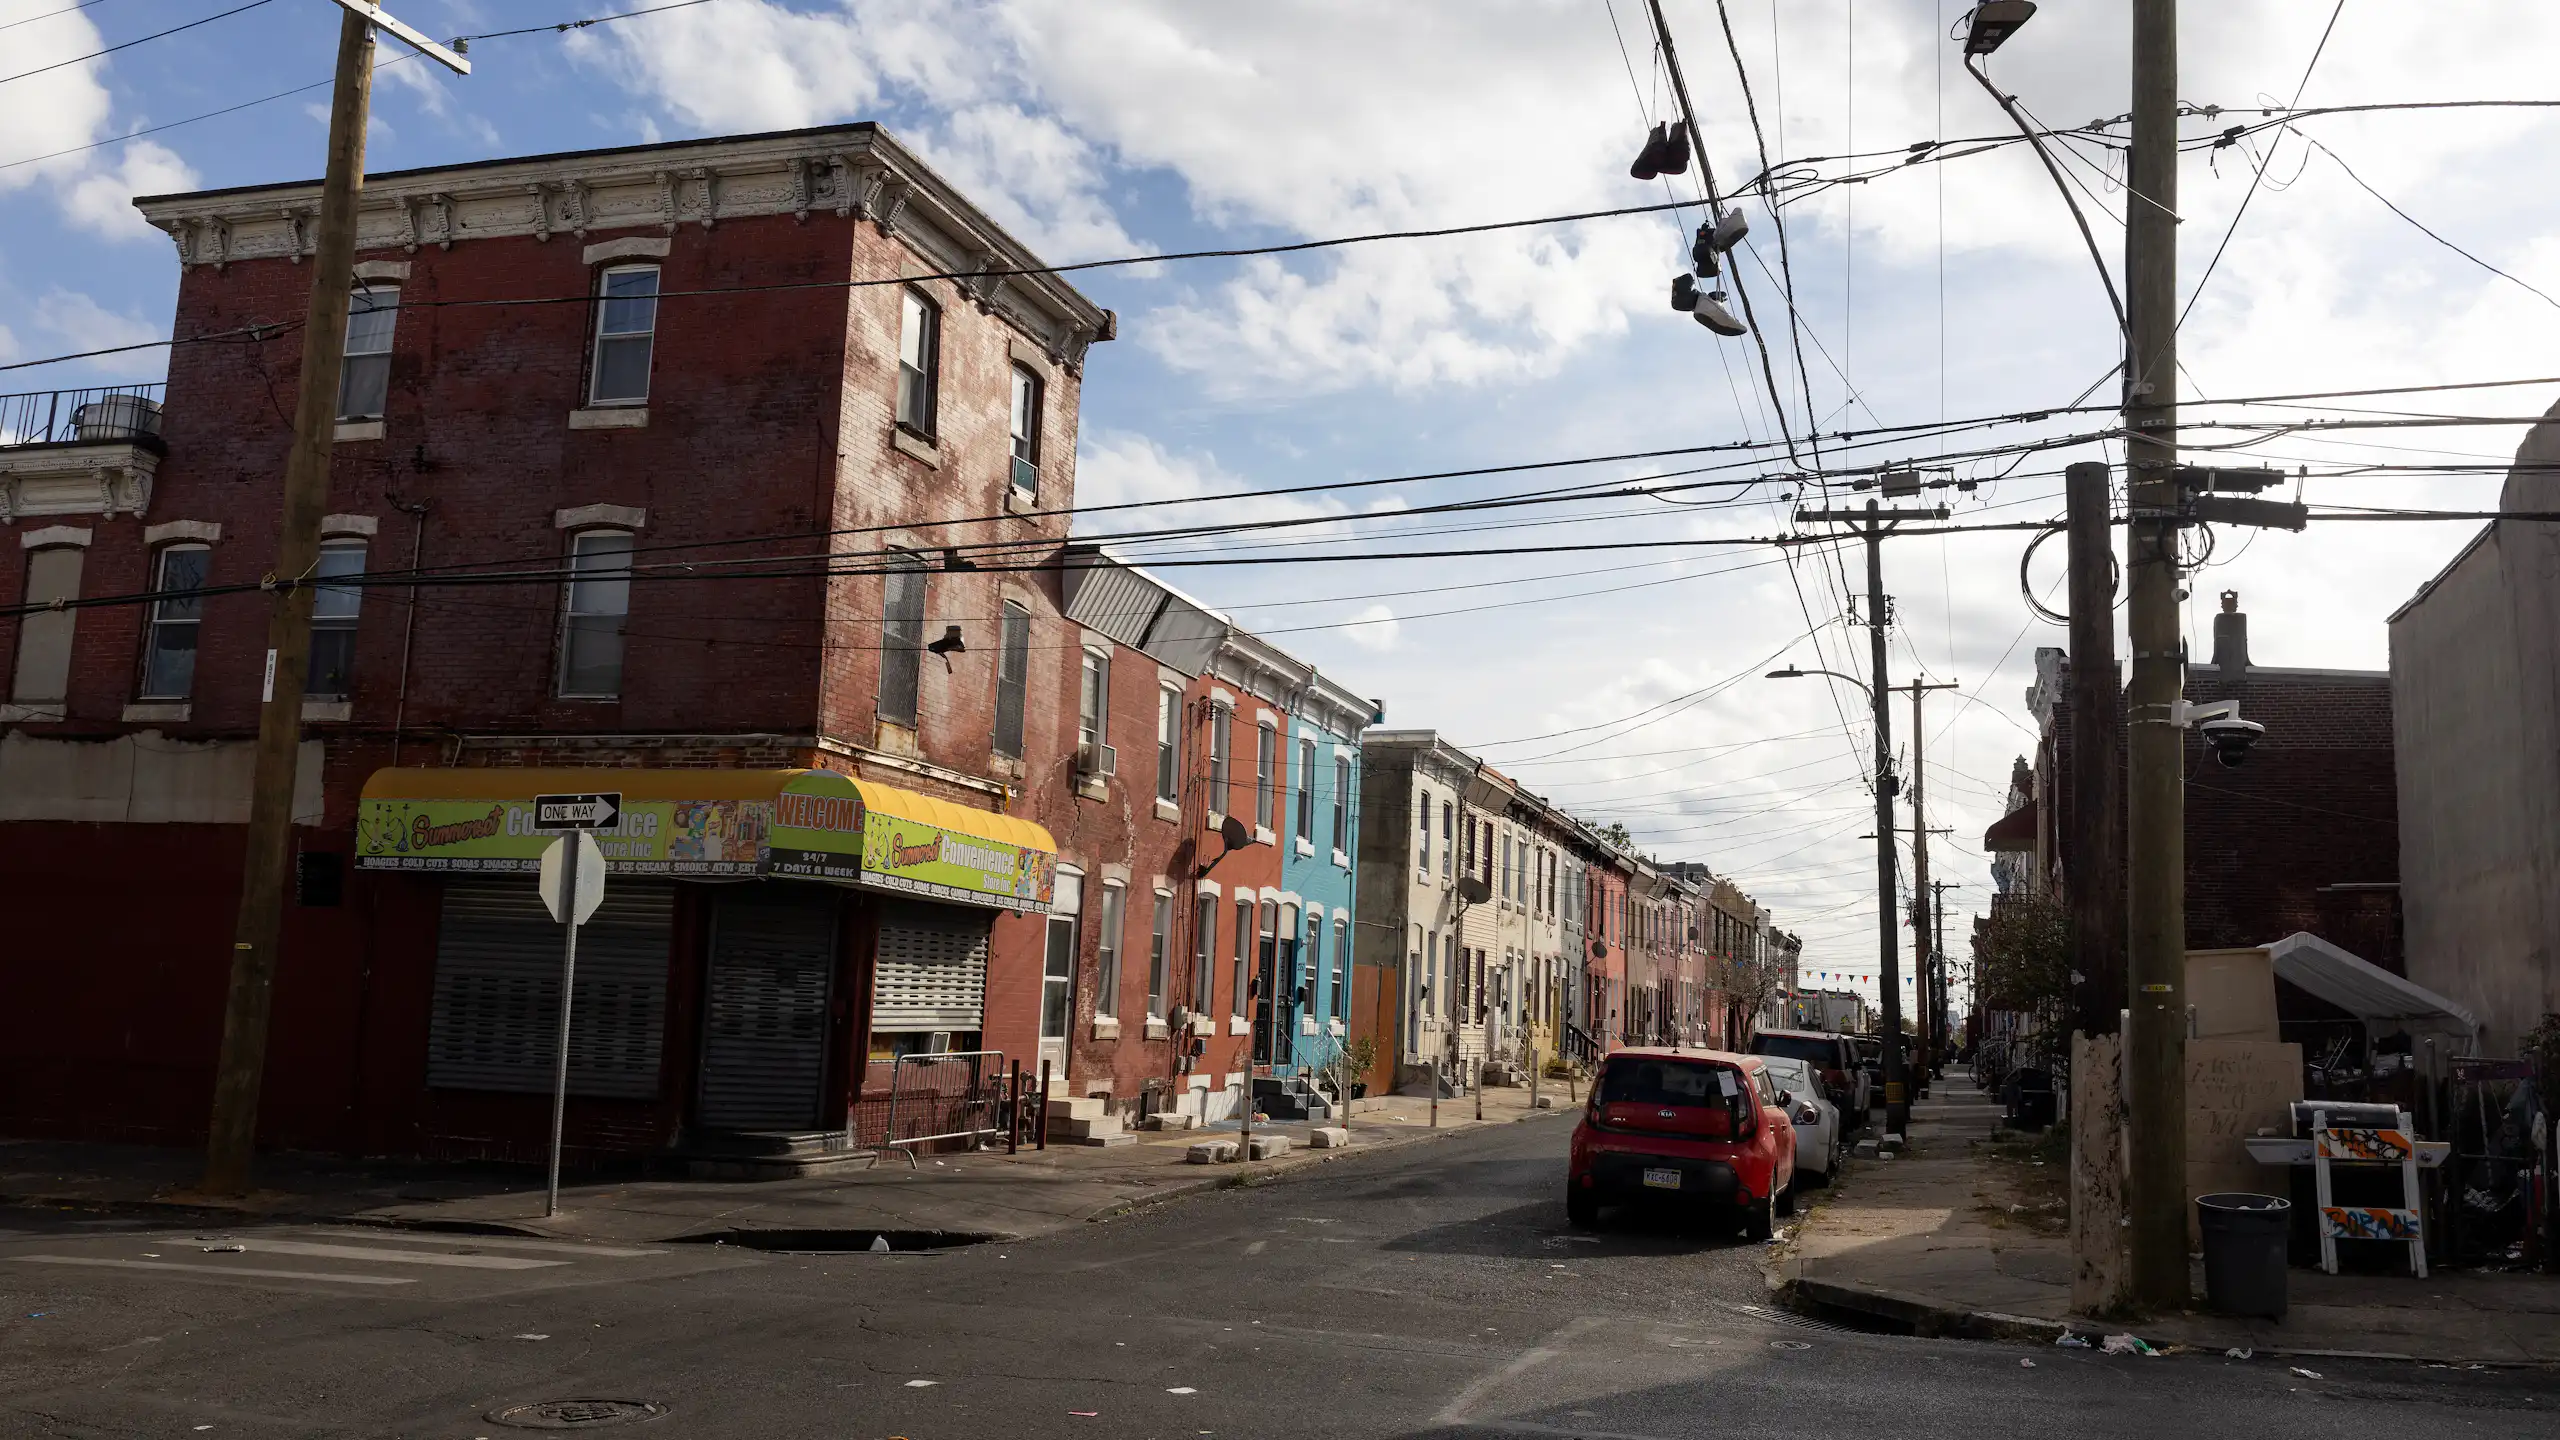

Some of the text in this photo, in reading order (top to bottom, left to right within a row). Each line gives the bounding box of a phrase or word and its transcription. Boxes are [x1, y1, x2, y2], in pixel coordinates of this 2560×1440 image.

[544, 805, 596, 819] ONE WAY
[775, 793, 865, 833] WELCOME
[411, 804, 504, 850] Summerset
[630, 840, 652, 857] Inc
[891, 832, 1015, 876] Summerset Convenience
[364, 857, 399, 867] HOAGIES
[402, 858, 425, 868] COLD
[426, 858, 448, 868] CUTS
[451, 858, 479, 869] SODAS
[483, 859, 518, 869] SNACKS
[803, 852, 827, 863] 24/7
[619, 862, 635, 871] ICE
[636, 862, 669, 871] CREAM
[674, 863, 708, 872] SMOKE
[712, 863, 734, 872] ATM
[738, 864, 757, 872] EBT
[773, 862, 781, 871] 7
[784, 864, 812, 874] DAYS
[824, 866, 854, 877] WEEK
[885, 876, 899, 887] COLD
[899, 878, 912, 889] CUTS
[983, 873, 1011, 892] Store Inc
